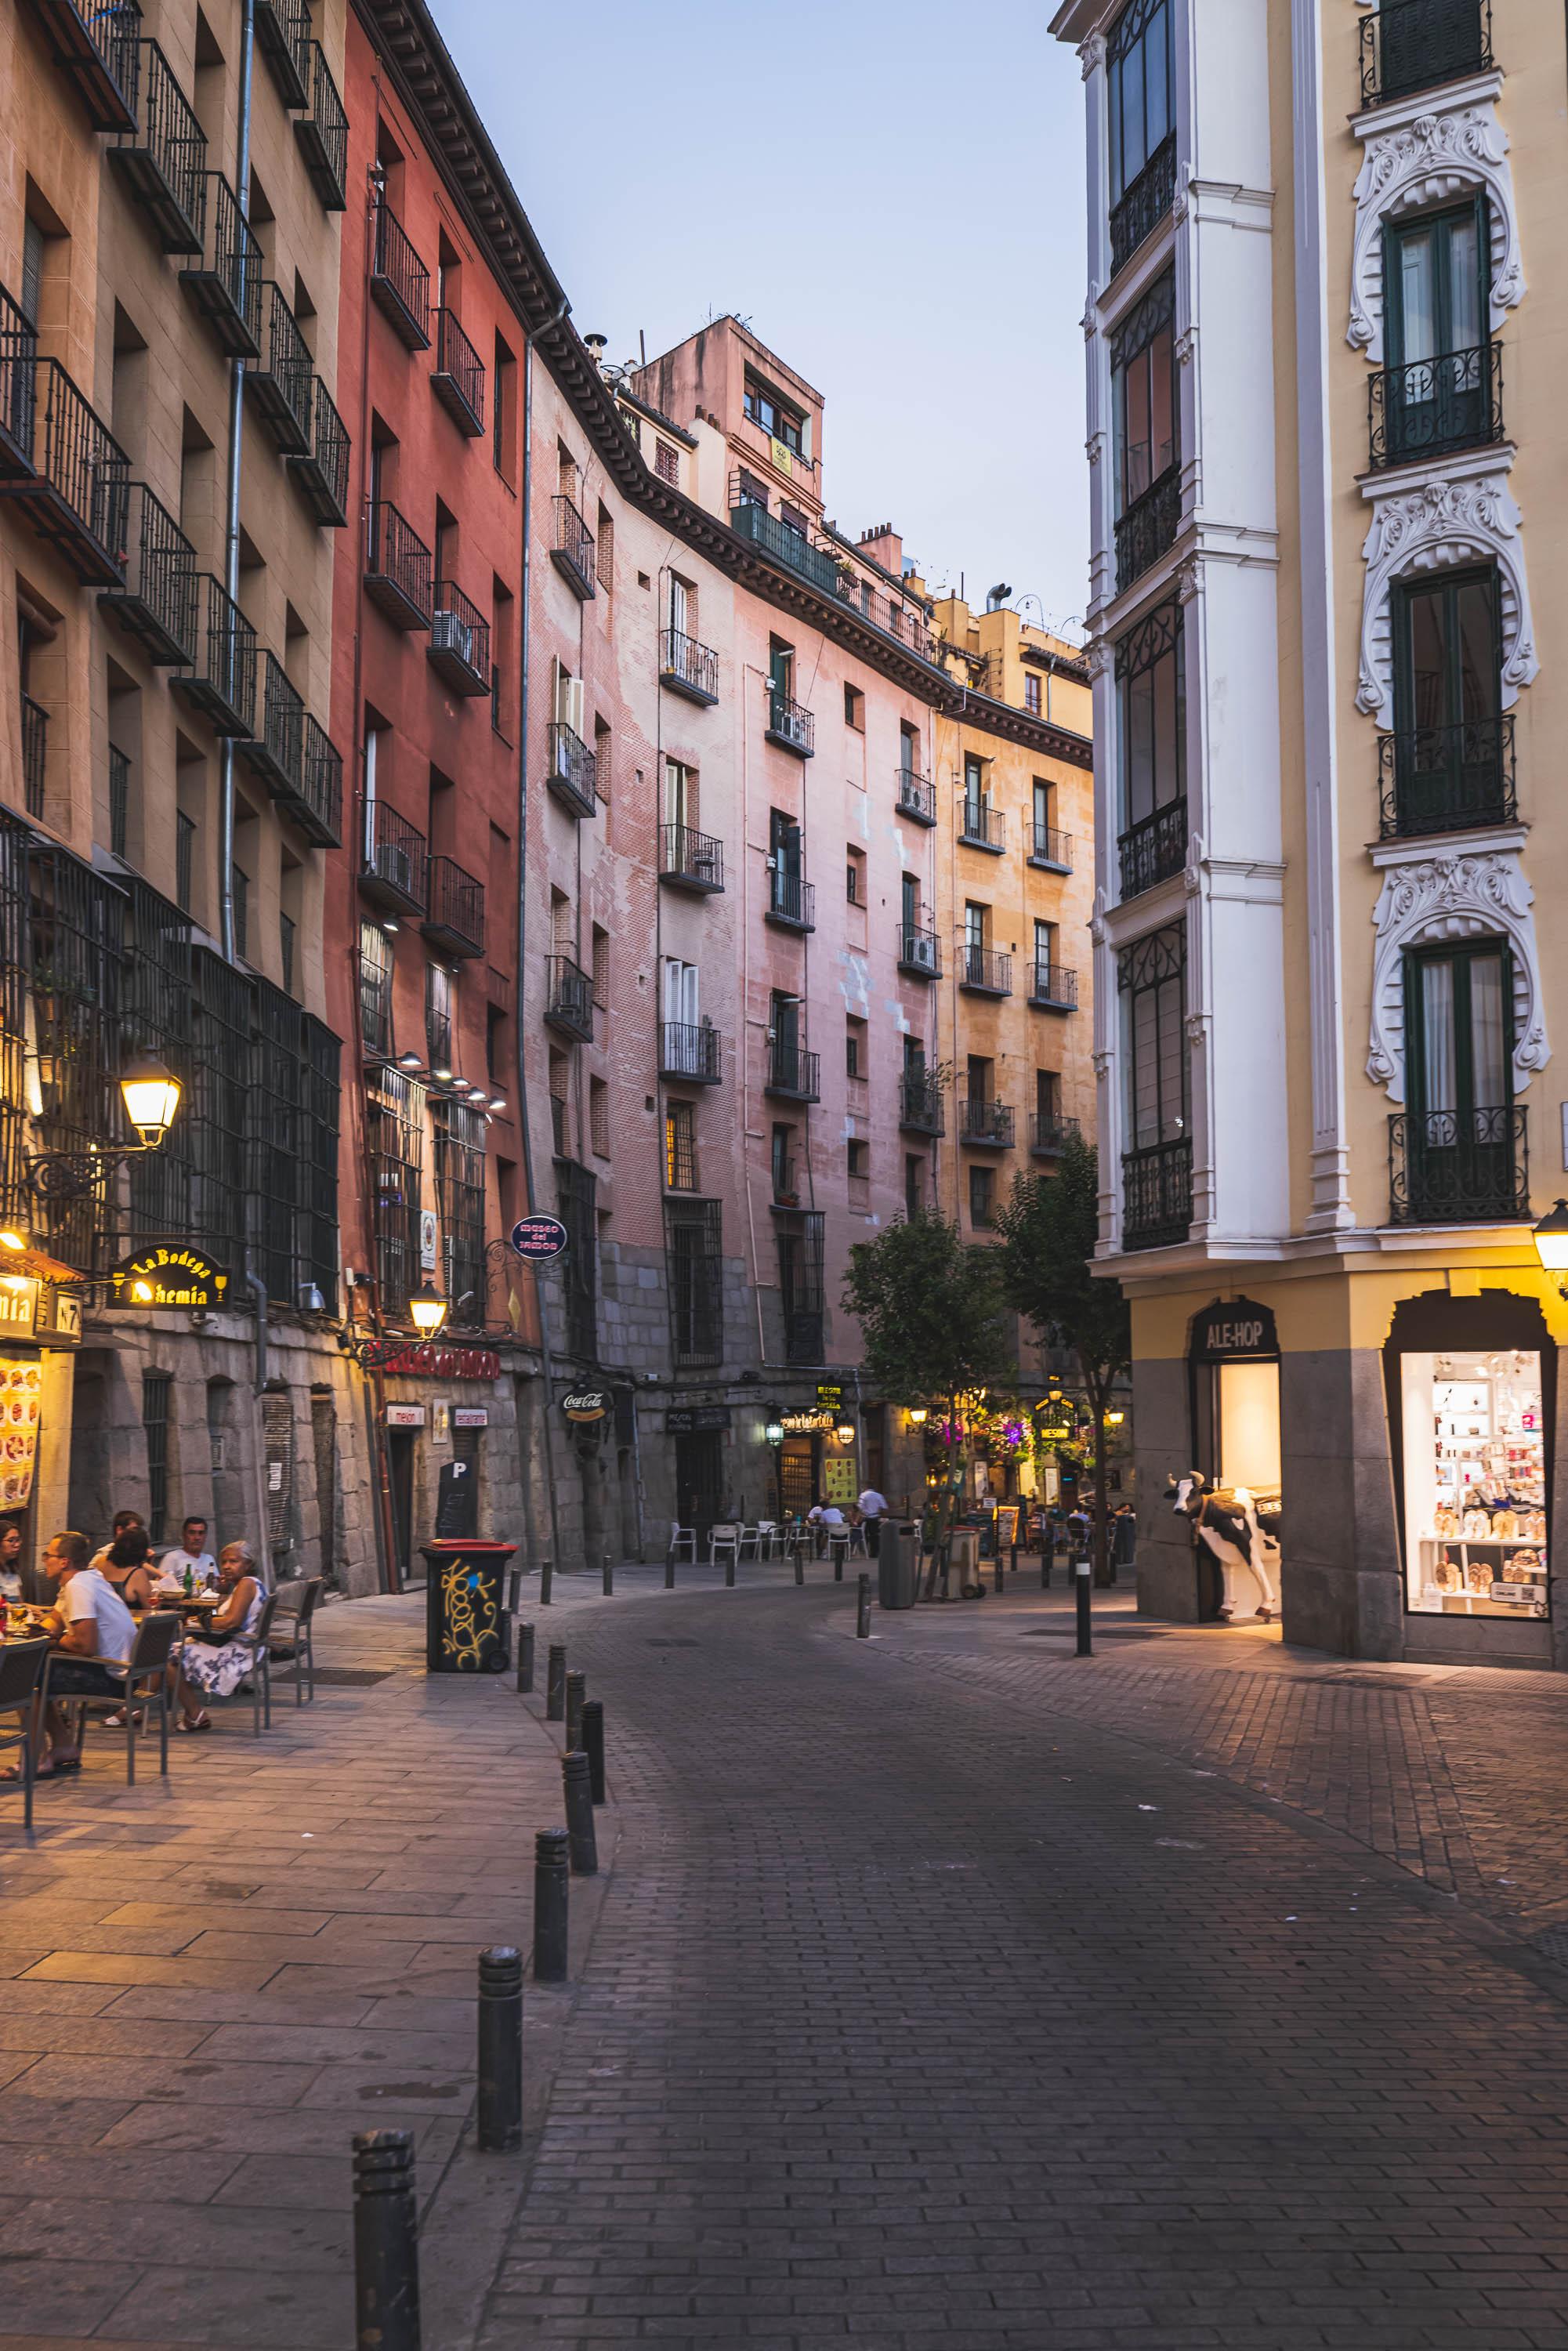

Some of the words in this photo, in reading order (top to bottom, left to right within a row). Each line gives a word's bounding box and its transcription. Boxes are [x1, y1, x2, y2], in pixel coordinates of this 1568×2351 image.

[130, 1258, 157, 1274] La
[155, 1248, 212, 1279] Bodega
[129, 1283, 208, 1305] Bhemia
[1207, 1320, 1263, 1349] ALE-HOP
[452, 1462, 467, 1478] P
